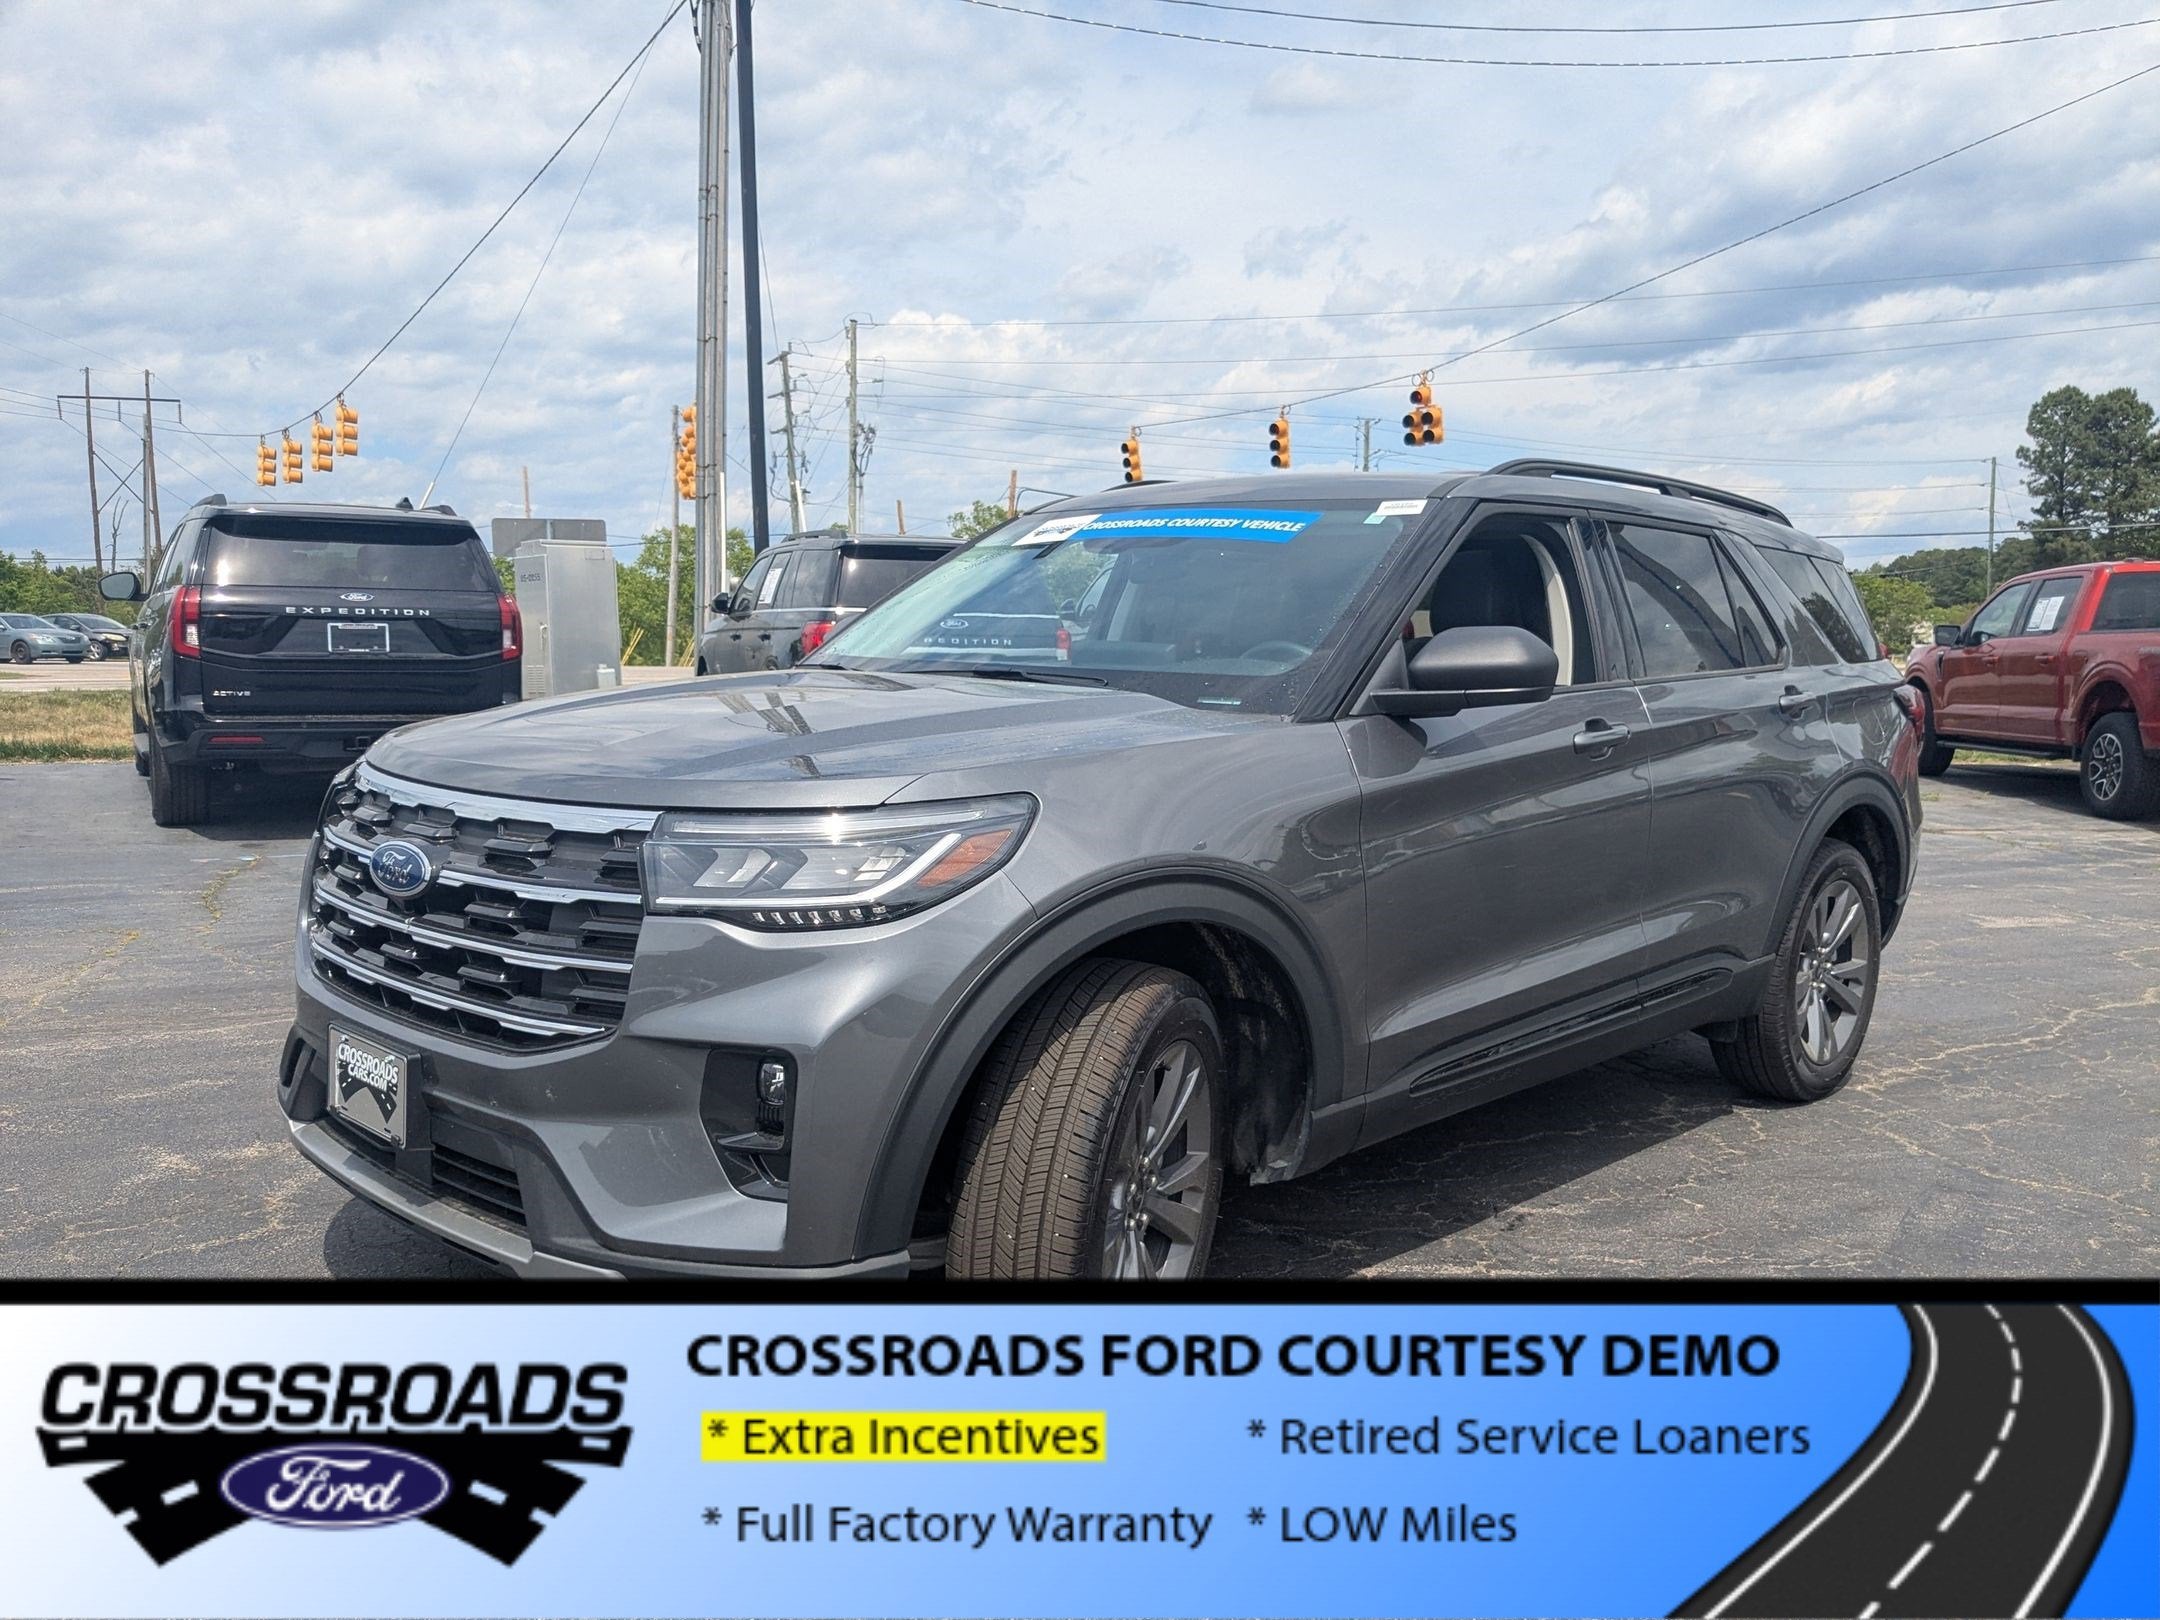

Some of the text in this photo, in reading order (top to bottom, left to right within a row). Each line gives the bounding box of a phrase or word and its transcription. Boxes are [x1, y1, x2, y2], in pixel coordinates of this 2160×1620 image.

[1082, 518, 1169, 531] CROSSROADS
[1167, 518, 1242, 528] COURTESY
[1241, 519, 1306, 532] VEHICLE
[285, 606, 430, 617] EXPEDITION
[924, 637, 1012, 646] PEDITION
[378, 850, 413, 884] Ford
[338, 1043, 399, 1084] CROSSROADS
[347, 1064, 388, 1092] CARS.COM
